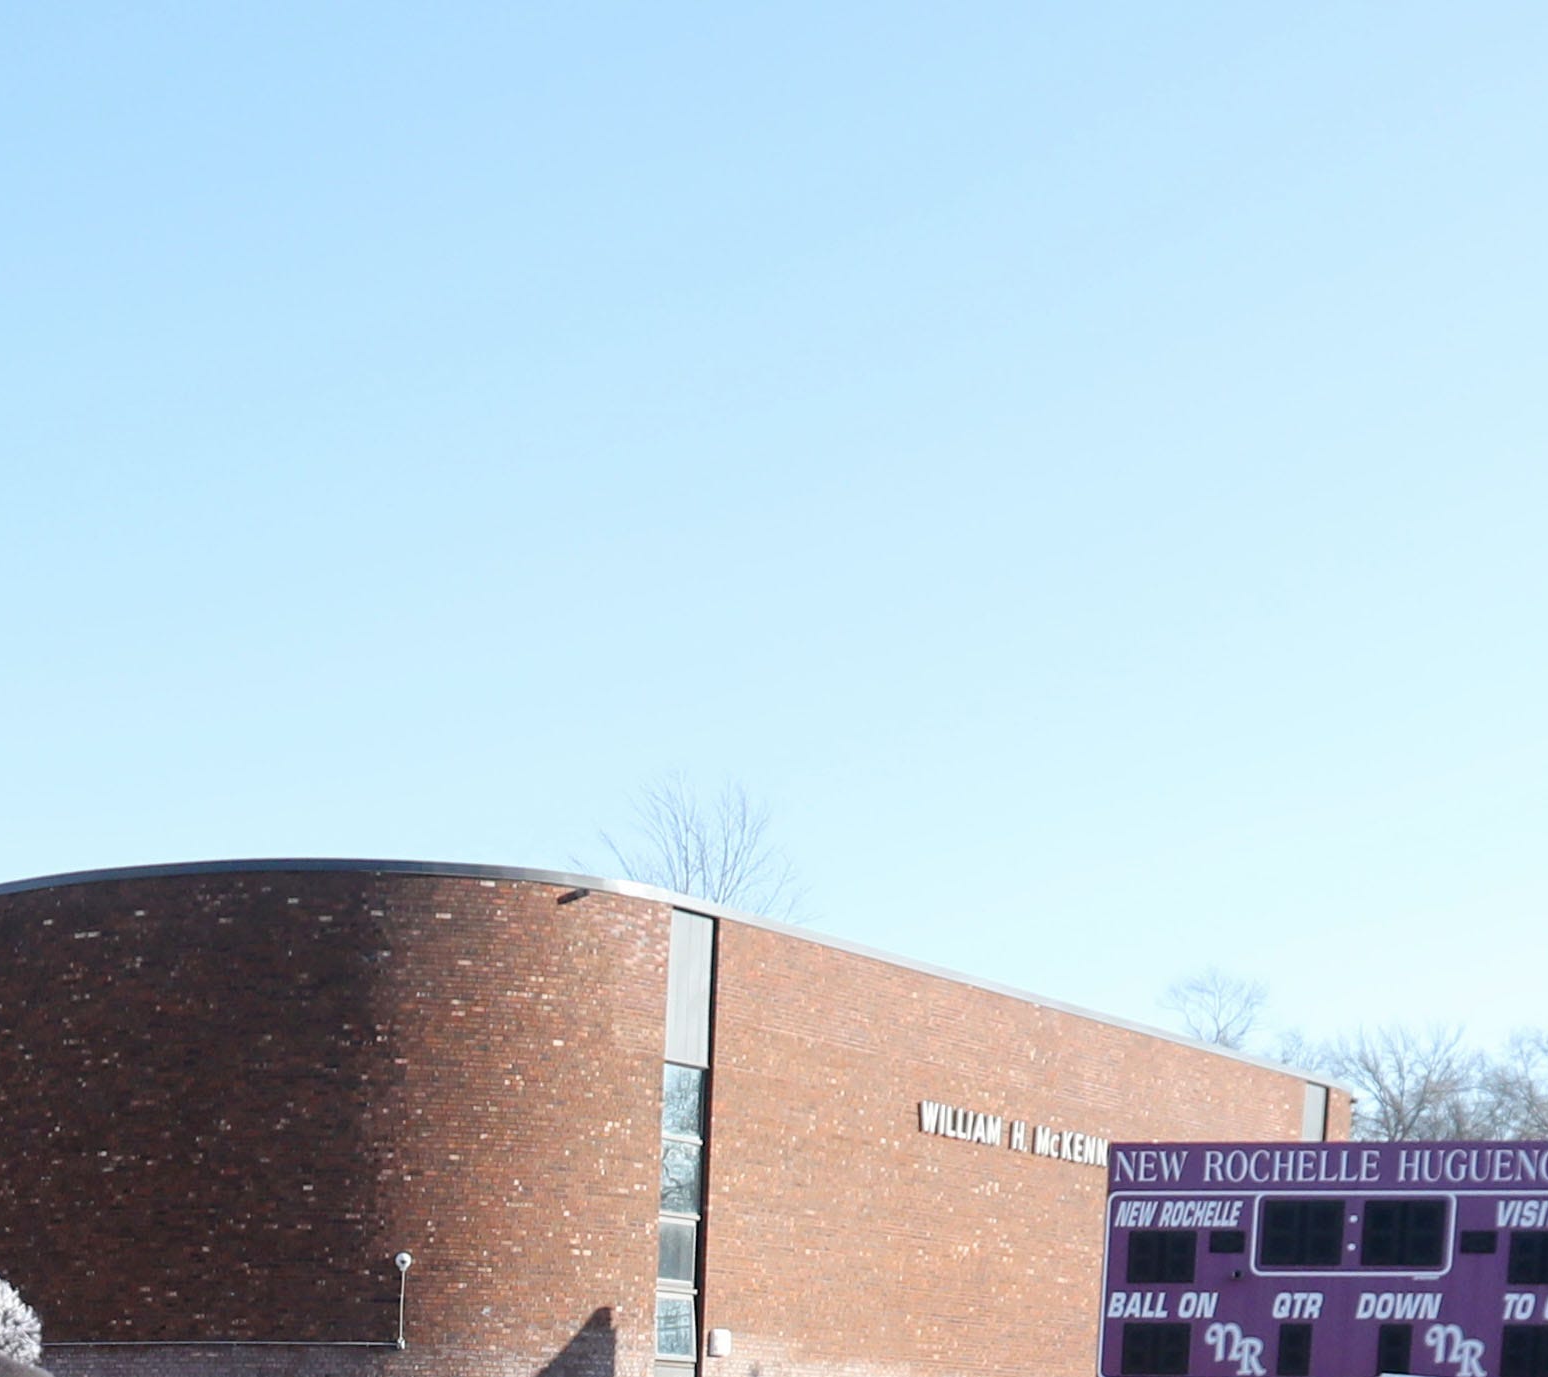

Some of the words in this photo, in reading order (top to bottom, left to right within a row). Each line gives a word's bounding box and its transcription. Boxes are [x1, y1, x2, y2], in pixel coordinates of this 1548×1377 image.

[921, 1100, 1002, 1146] WILLIAM
[1011, 1120, 1028, 1153] H.
[1114, 1149, 1189, 1183] NEW
[1203, 1149, 1380, 1183] ROCHELLE
[1114, 1201, 1158, 1228] NEW
[1157, 1201, 1244, 1228] ROCHELLE
[1107, 1292, 1169, 1318] BALL
[1177, 1292, 1219, 1318] ON
[1272, 1292, 1324, 1319] QTR
[1356, 1293, 1443, 1320] DOWN
[1503, 1293, 1536, 1320] TO
